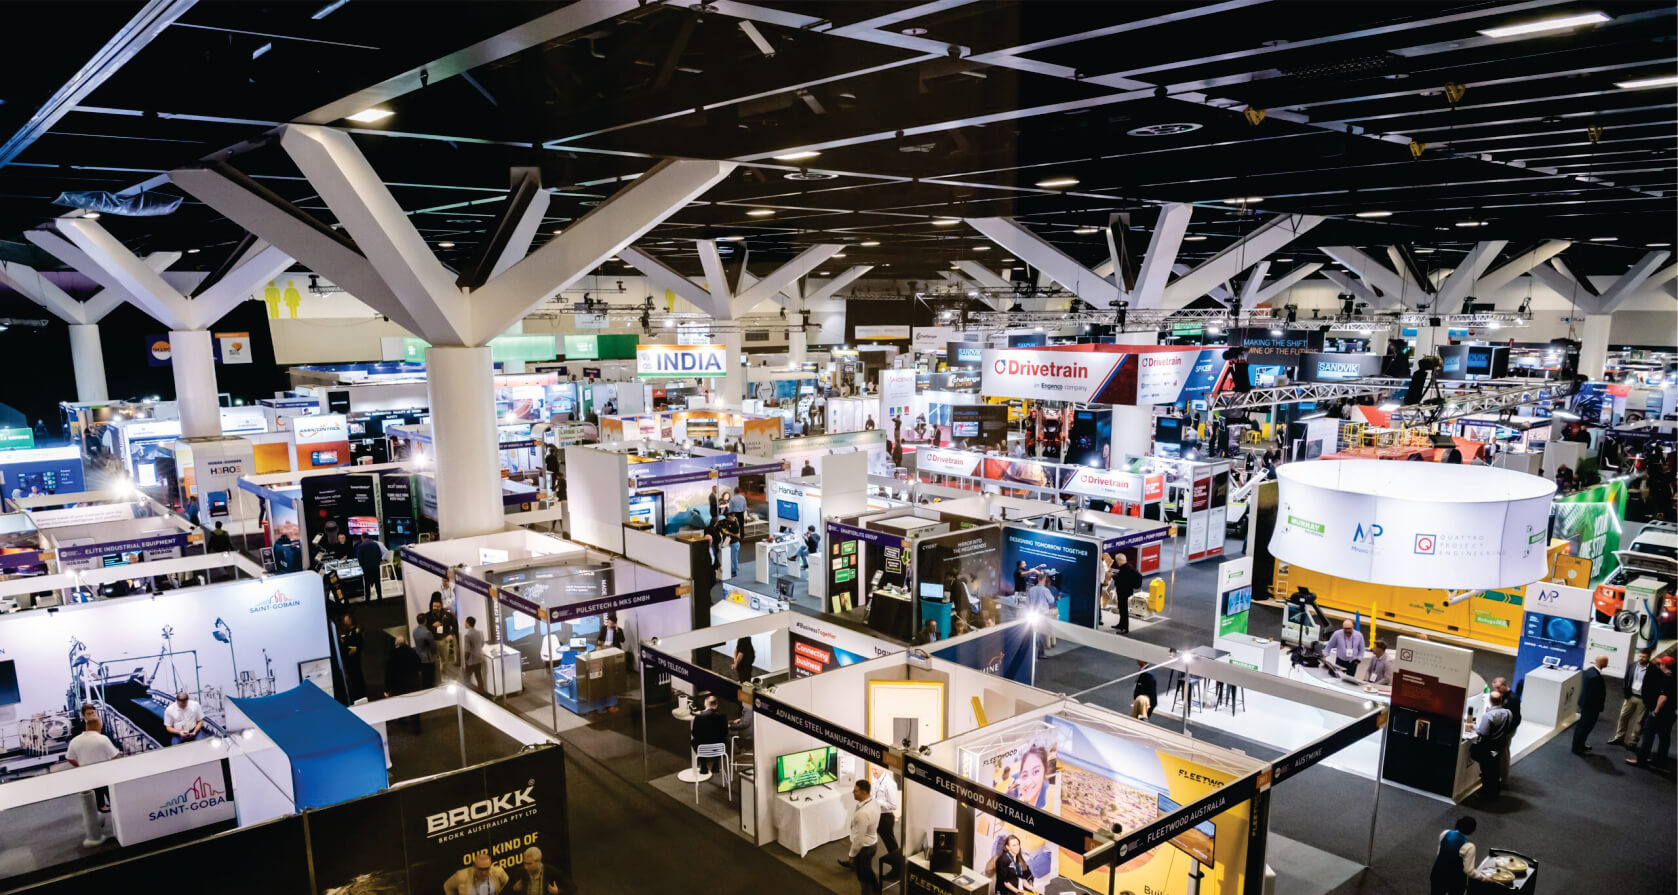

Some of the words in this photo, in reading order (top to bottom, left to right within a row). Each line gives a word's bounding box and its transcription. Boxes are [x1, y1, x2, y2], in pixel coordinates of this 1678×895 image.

[1243, 339, 1270, 347] MAKING
[1270, 339, 1285, 347] THE
[1286, 339, 1308, 348] SHIFT
[1264, 347, 1274, 355] OF
[656, 351, 722, 371] INDIA
[1007, 359, 1088, 379] Drivetrain
[1148, 355, 1182, 368] Drivetrain
[1318, 363, 1359, 373] SANDVIK
[1064, 384, 1088, 392] company
[932, 453, 964, 466] Drivetrain
[778, 486, 804, 497] Hanwha
[1088, 475, 1129, 490] Drivetrain
[84, 547, 102, 555] ELITE
[103, 542, 141, 553] INDUSTRIAL
[141, 537, 176, 548] EQUIPMENT
[1009, 535, 1034, 546] DESIGNING
[1034, 540, 1061, 552] TOMORROW
[1062, 545, 1088, 557] TOGETHER
[249, 599, 301, 614] SAINT-GOBAIN
[575, 601, 612, 614] PULSETECH
[618, 598, 632, 607] MKS
[632, 595, 650, 604] GMBH
[796, 643, 829, 662] Connecting
[657, 657, 667, 668] TPG
[666, 661, 689, 677] TELECOM
[796, 657, 821, 672] business
[775, 708, 804, 727] ADVANCE
[803, 720, 824, 735] STEEL
[824, 728, 881, 759] MANUFACTURING
[983, 748, 1018, 767] FLEETWOOD
[1294, 747, 1323, 768] AUSTMINE
[425, 785, 537, 834] BROKK
[935, 776, 985, 805] FLEETWOOD
[986, 798, 1035, 827] AUSTRALIA
[438, 831, 465, 844] BROKK
[467, 818, 508, 835] AUSTRALIA
[510, 813, 523, 822] PTY
[525, 808, 538, 817] LTD
[1147, 815, 1190, 844] FLEETWOOD
[1189, 797, 1226, 821] AUSTRALIA
[492, 837, 521, 857] KIND
[523, 831, 539, 846] OF
